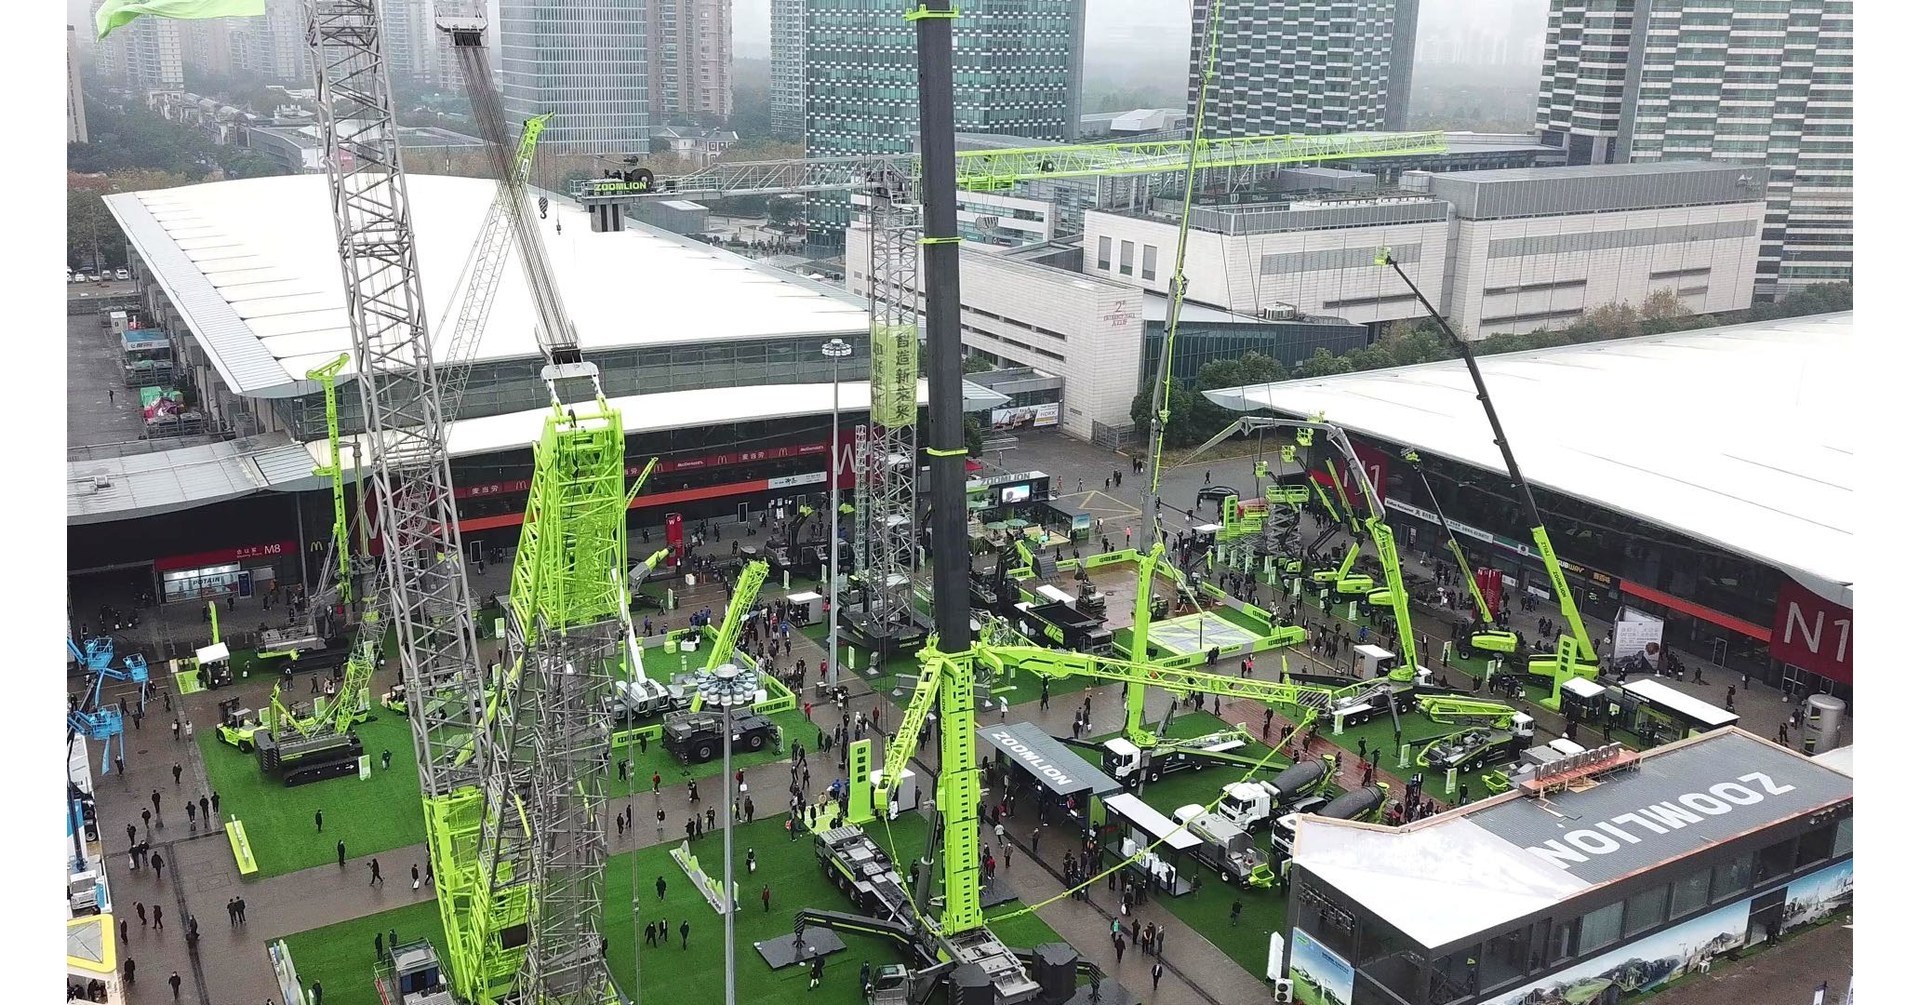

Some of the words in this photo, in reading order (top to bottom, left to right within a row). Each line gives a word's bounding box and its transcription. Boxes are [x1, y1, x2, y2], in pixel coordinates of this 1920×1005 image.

[594, 181, 647, 191] ZOOMLION
[980, 472, 1031, 486] ZOOMLION
[264, 543, 282, 555] M8
[192, 576, 221, 586] POTAIN
[1552, 571, 1567, 598] ZOOMLION
[1783, 601, 1851, 662] N1
[992, 730, 1073, 786] ZOOMLION
[1526, 771, 1797, 870] ZOOMLION
